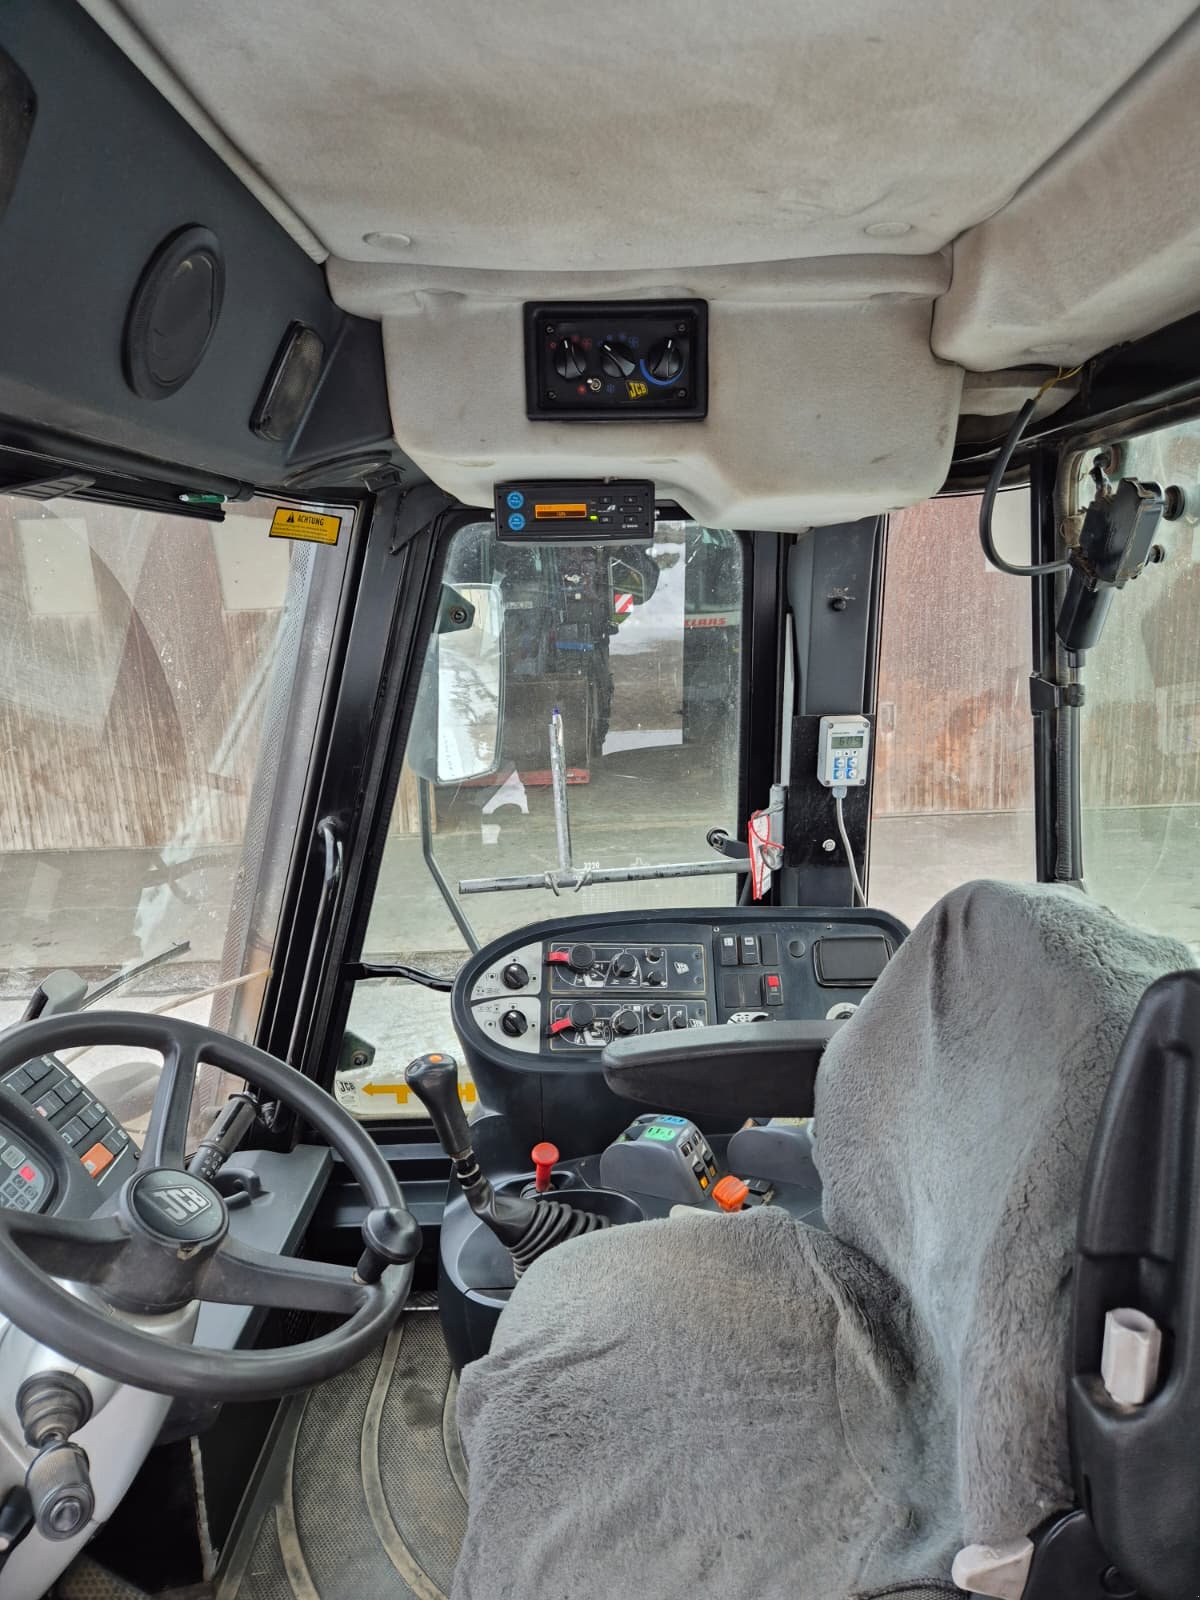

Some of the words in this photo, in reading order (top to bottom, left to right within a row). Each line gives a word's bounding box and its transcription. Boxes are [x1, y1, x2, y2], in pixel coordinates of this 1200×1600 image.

[629, 382, 647, 398] JCB
[297, 514, 325, 526] ACHTUNG
[340, 1081, 356, 1093] JCB
[152, 1188, 207, 1220] JCB
